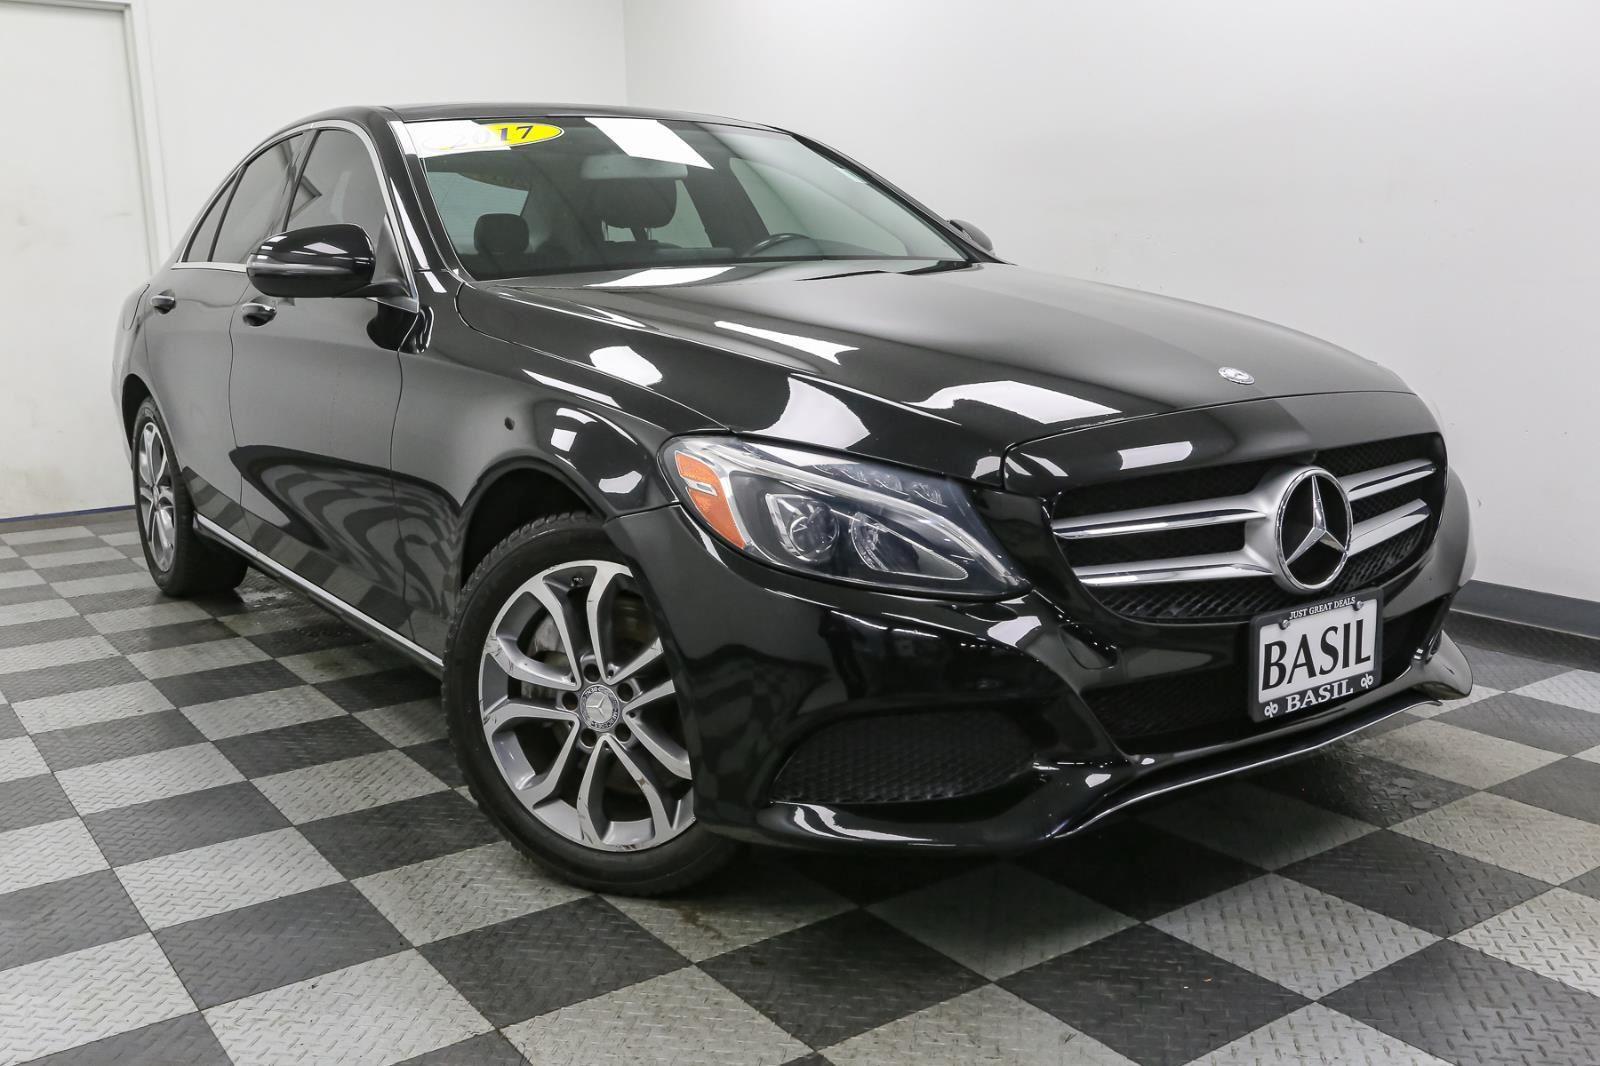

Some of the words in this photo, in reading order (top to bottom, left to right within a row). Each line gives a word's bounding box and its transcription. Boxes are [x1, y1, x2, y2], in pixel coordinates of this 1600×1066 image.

[1289, 608, 1308, 620] JUST
[1309, 602, 1333, 615] GREAT
[1334, 596, 1356, 609] DEALS
[1261, 618, 1371, 691] BASIL
[1285, 679, 1354, 713] BASIL
